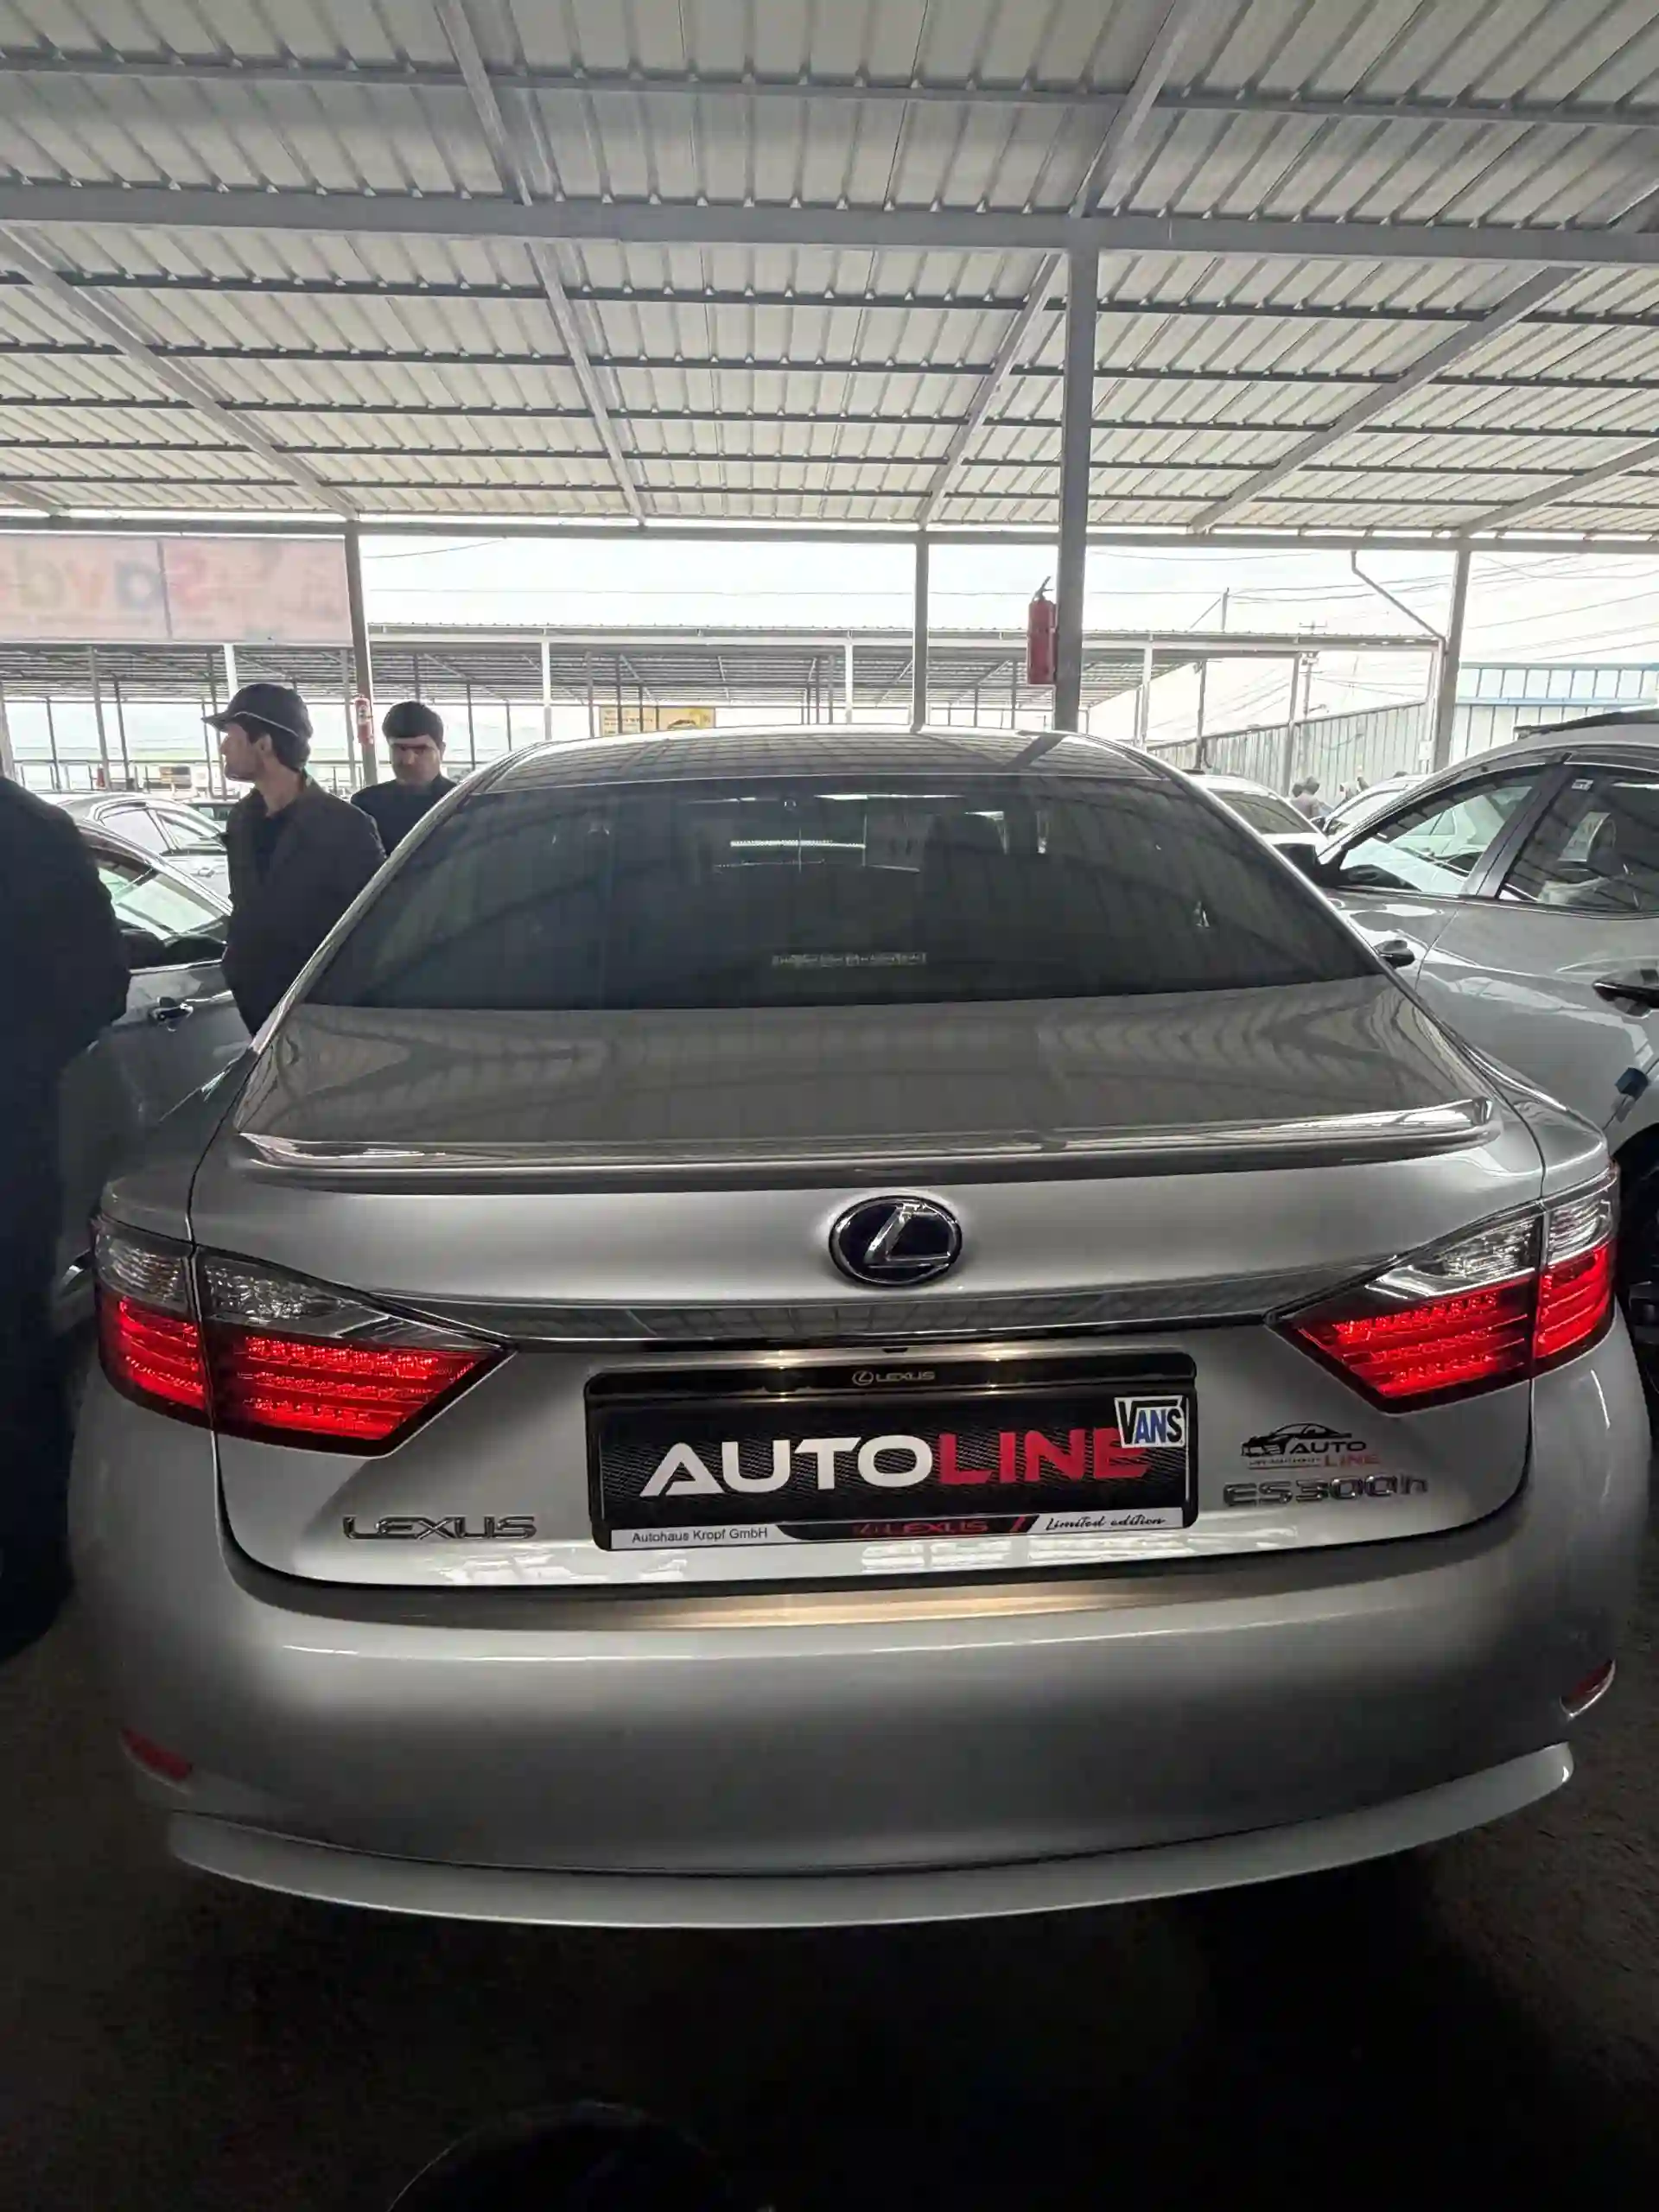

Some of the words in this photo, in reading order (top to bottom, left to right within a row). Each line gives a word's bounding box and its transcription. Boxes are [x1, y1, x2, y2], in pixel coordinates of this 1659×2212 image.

[875, 1370, 936, 1382] LEXUS
[1117, 1399, 1183, 1444] VANS
[1289, 1440, 1367, 1454] AUTO
[639, 1427, 1151, 1497] AUTOLINE
[1324, 1454, 1380, 1467] LINE
[342, 1515, 537, 1540] LEXUS
[883, 1520, 988, 1535] LEXUS
[1046, 1516, 1107, 1531] Limited
[1110, 1514, 1166, 1526] edition
[632, 1533, 690, 1543] Autohaus
[693, 1529, 727, 1541] Kropf
[729, 1527, 768, 1539] GmbH
